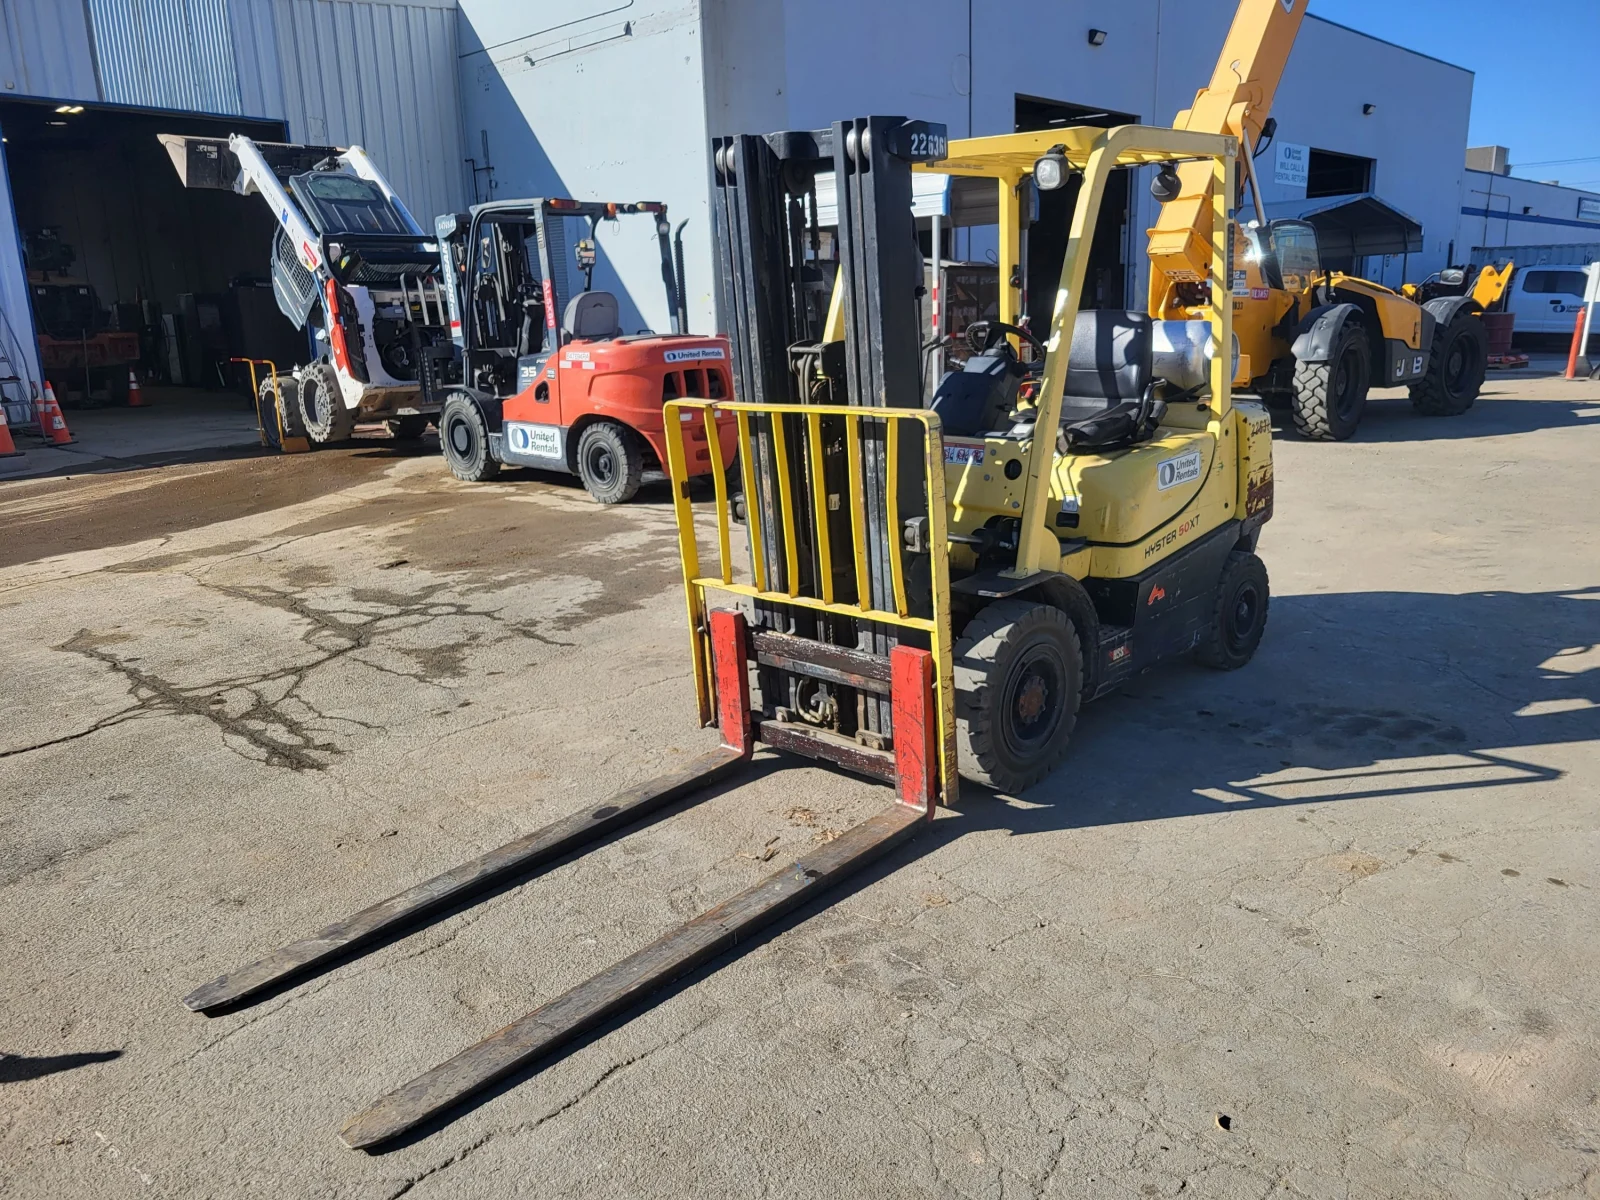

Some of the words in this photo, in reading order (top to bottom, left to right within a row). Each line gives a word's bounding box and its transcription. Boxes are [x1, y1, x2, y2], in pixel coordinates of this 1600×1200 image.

[1290, 163, 1300, 172] CALL
[677, 351, 700, 359] United
[701, 350, 722, 358] Rentals
[520, 366, 536, 377] 35
[530, 430, 555, 442] United
[531, 441, 559, 454] Rentals
[1176, 455, 1198, 471] United
[1175, 466, 1198, 481] Rentals
[1144, 529, 1177, 559] HYSTER
[1178, 513, 1201, 537] 50XT
